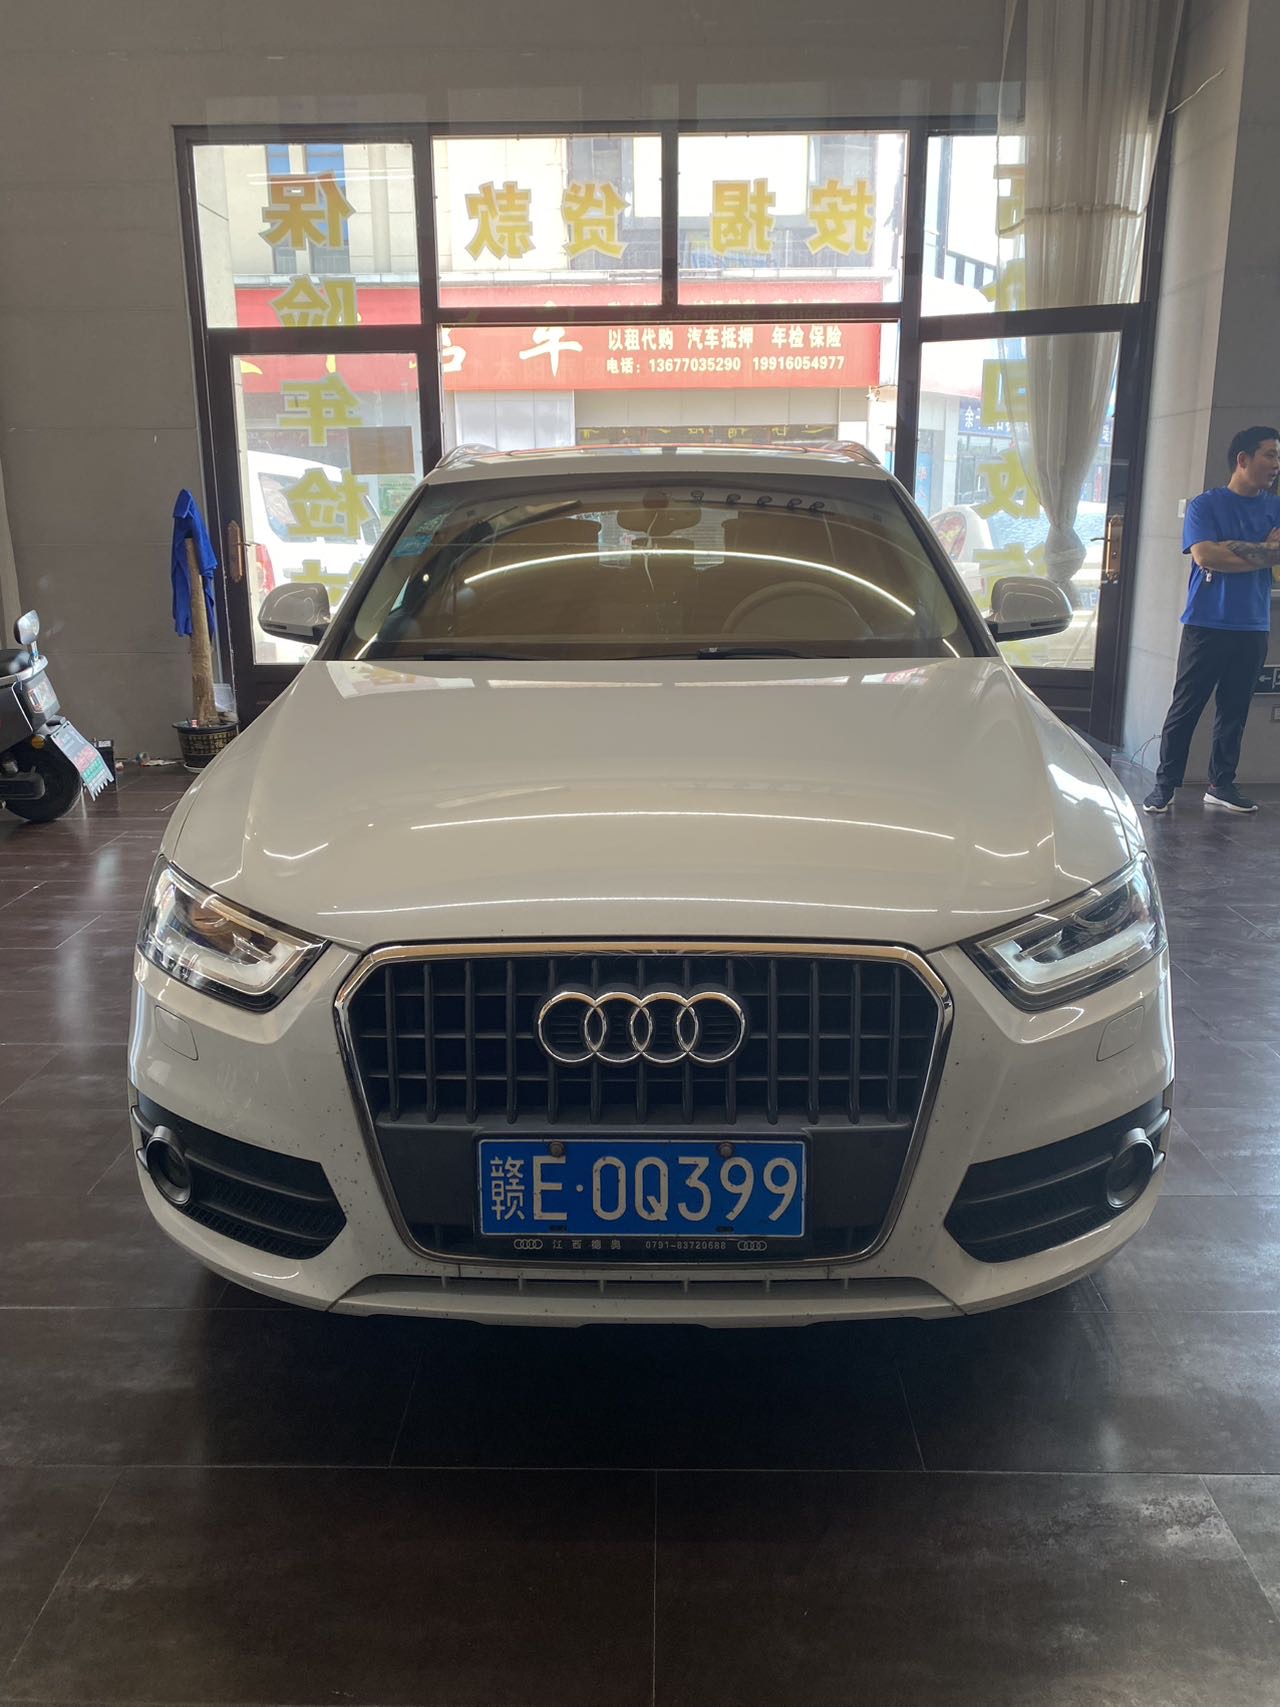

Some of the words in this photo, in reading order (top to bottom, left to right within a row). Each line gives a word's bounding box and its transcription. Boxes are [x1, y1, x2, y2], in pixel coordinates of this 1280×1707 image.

[608, 327, 673, 351] 以租代购
[687, 325, 754, 350] 汽车抵押
[771, 325, 804, 348] 年检
[809, 325, 842, 348] 保险
[649, 357, 741, 372] 13677035290
[753, 355, 844, 371] 19916054977
